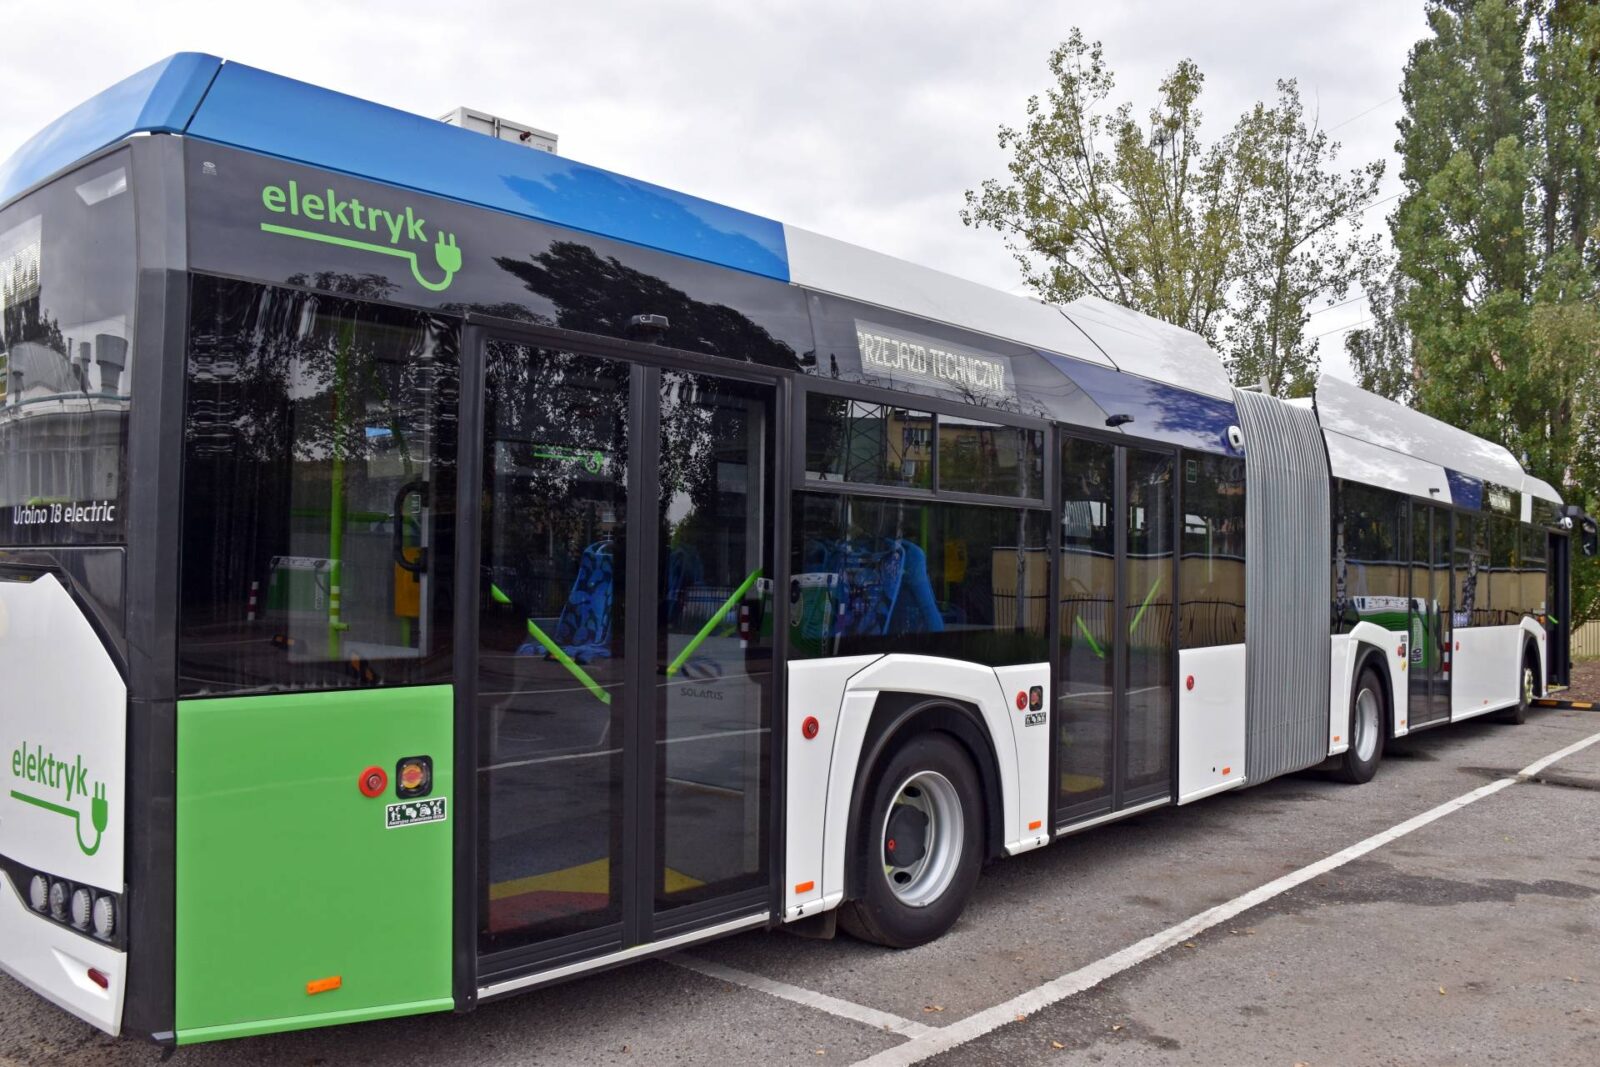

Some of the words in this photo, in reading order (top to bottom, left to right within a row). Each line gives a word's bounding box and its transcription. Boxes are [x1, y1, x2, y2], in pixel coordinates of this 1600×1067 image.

[262, 181, 428, 244] elektryk
[929, 348, 1004, 391] TECHNICZNY
[13, 505, 47, 525] Urbino
[50, 503, 62, 523] 18
[64, 500, 115, 522] electric
[680, 687, 723, 701] SOLARIS
[12, 741, 88, 801] elektryk
